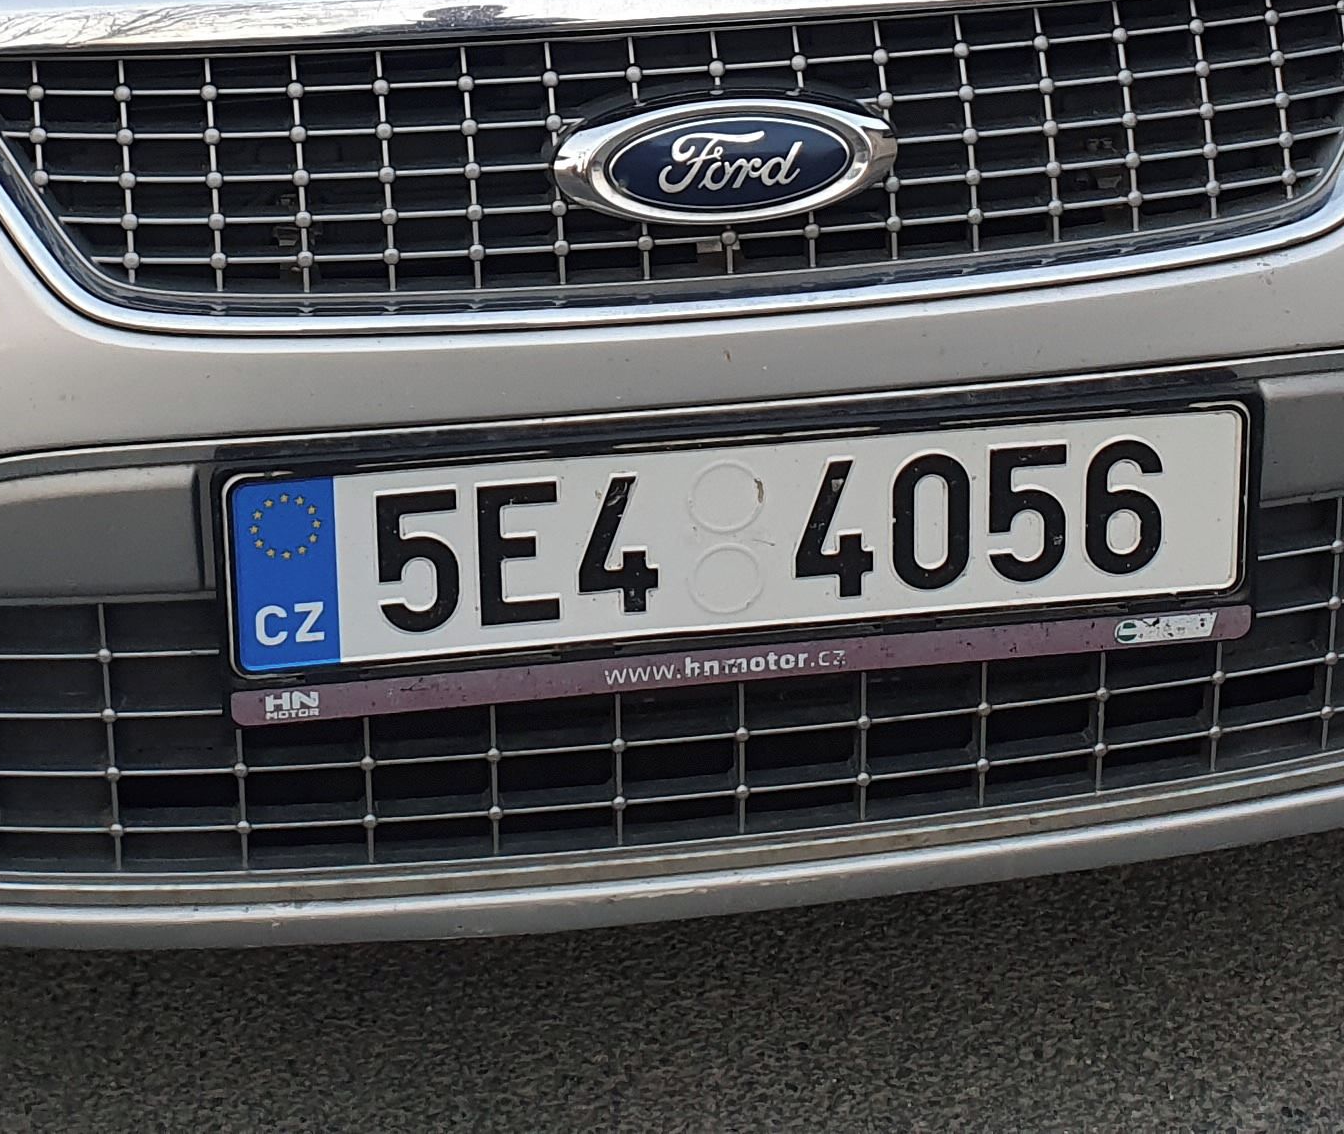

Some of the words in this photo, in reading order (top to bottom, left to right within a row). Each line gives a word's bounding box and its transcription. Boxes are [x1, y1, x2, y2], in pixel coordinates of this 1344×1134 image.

[658, 129, 803, 194] Ford
[374, 474, 660, 634] 5E4
[794, 438, 1164, 598] 4056
[255, 601, 325, 646] CZ
[604, 649, 847, 686] www.hnmotor.cz
[264, 690, 320, 712] HN
[265, 708, 320, 721] MOTOR
